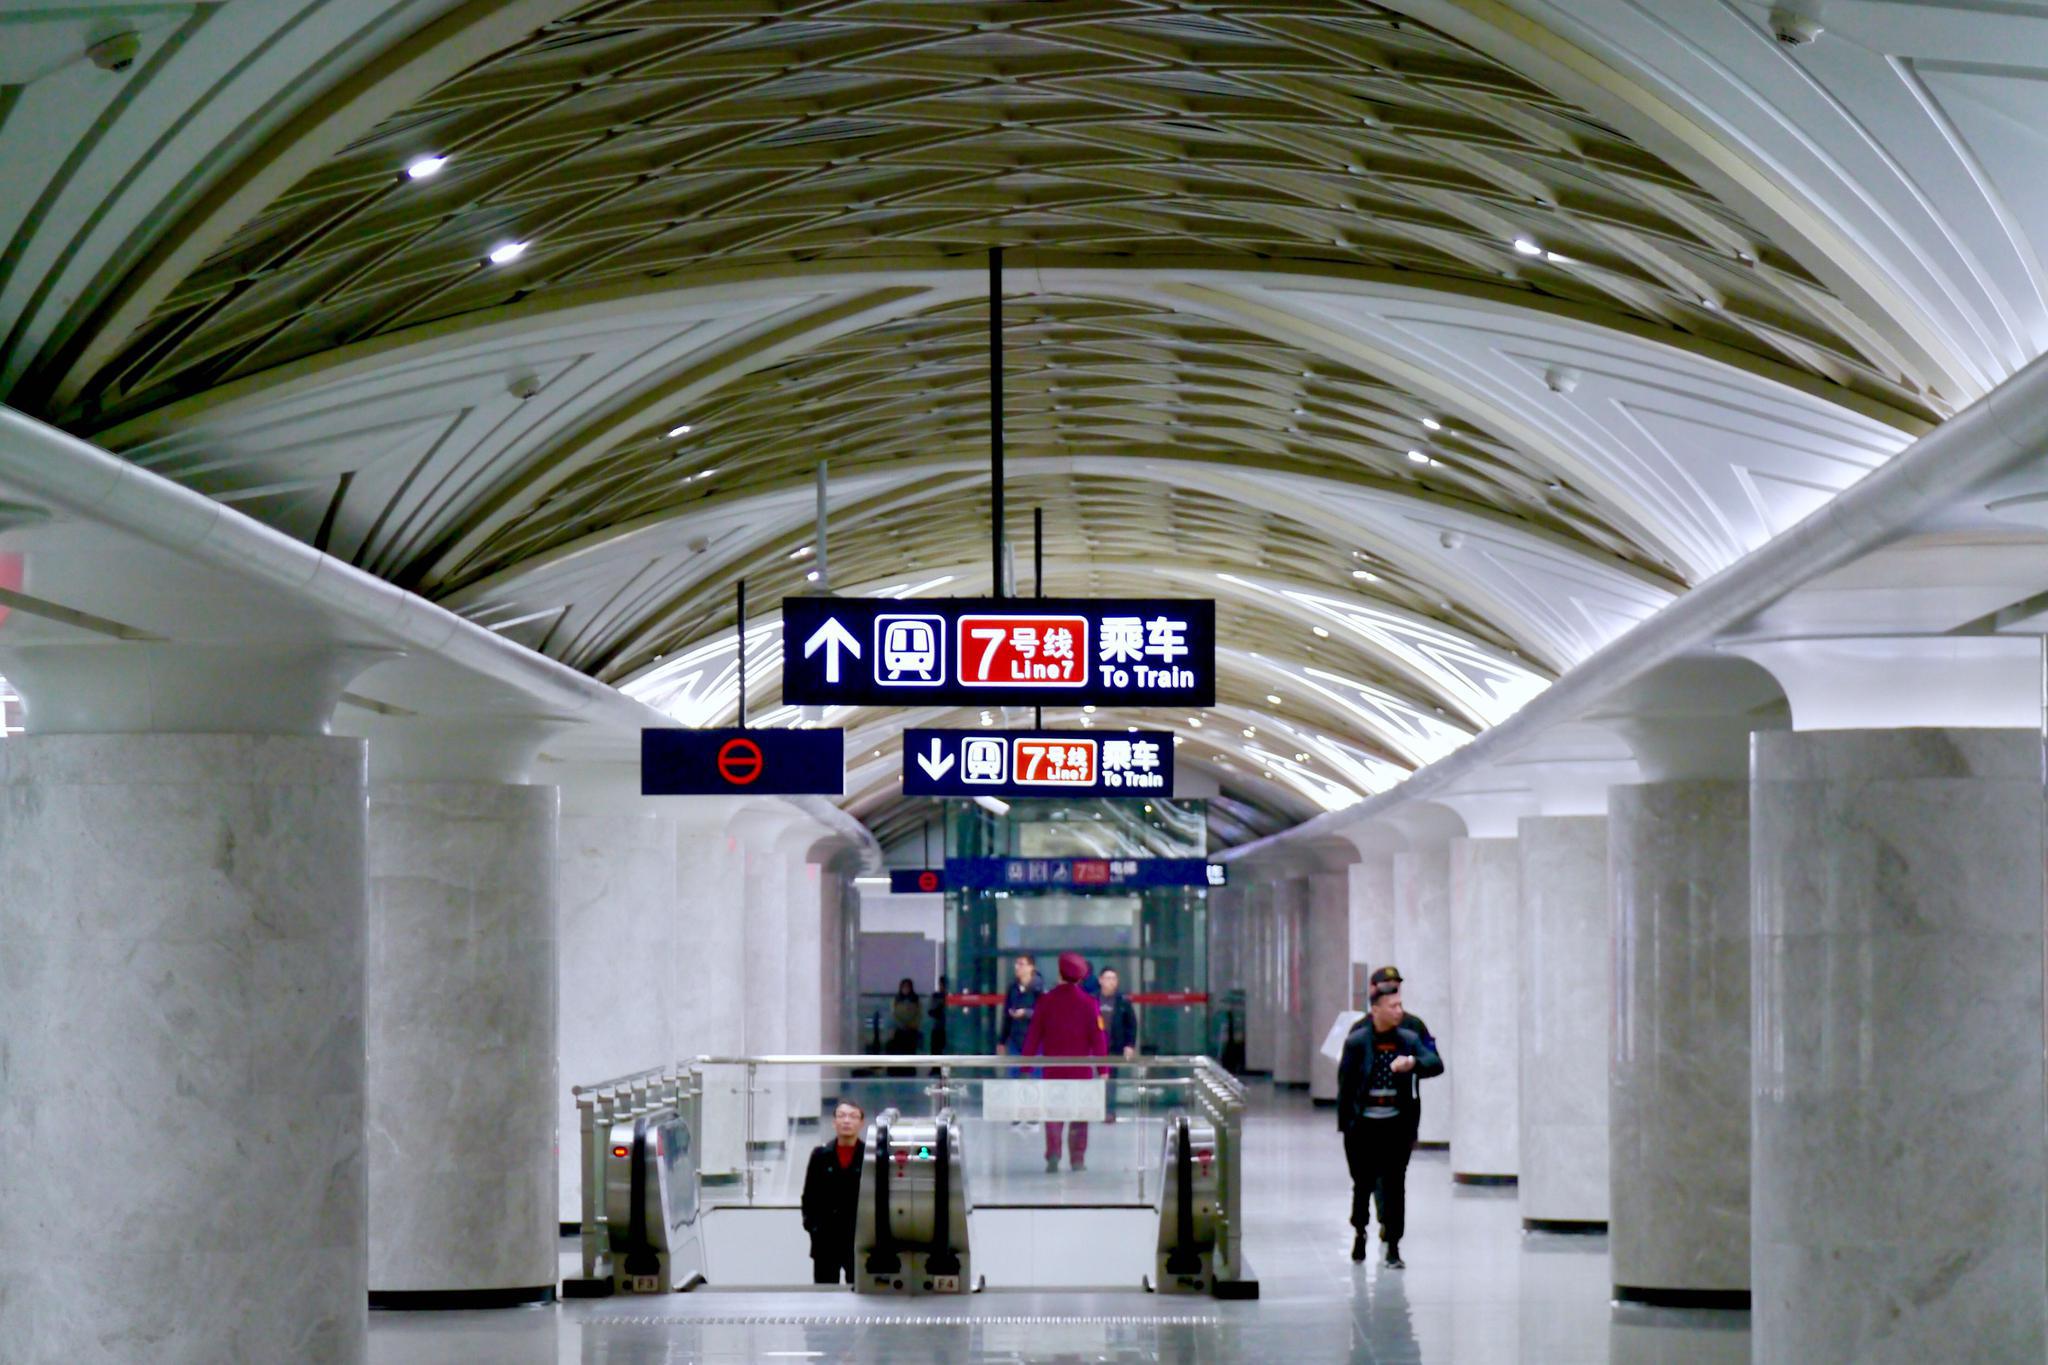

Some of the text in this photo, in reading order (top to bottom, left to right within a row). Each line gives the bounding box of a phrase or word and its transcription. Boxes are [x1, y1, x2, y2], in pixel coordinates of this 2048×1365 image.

[971, 627, 1074, 680] 7号线
[1099, 616, 1188, 663] 乘车
[1099, 665, 1194, 688] To Train
[1102, 741, 1160, 771] 乘车
[1102, 771, 1163, 787] To Train
